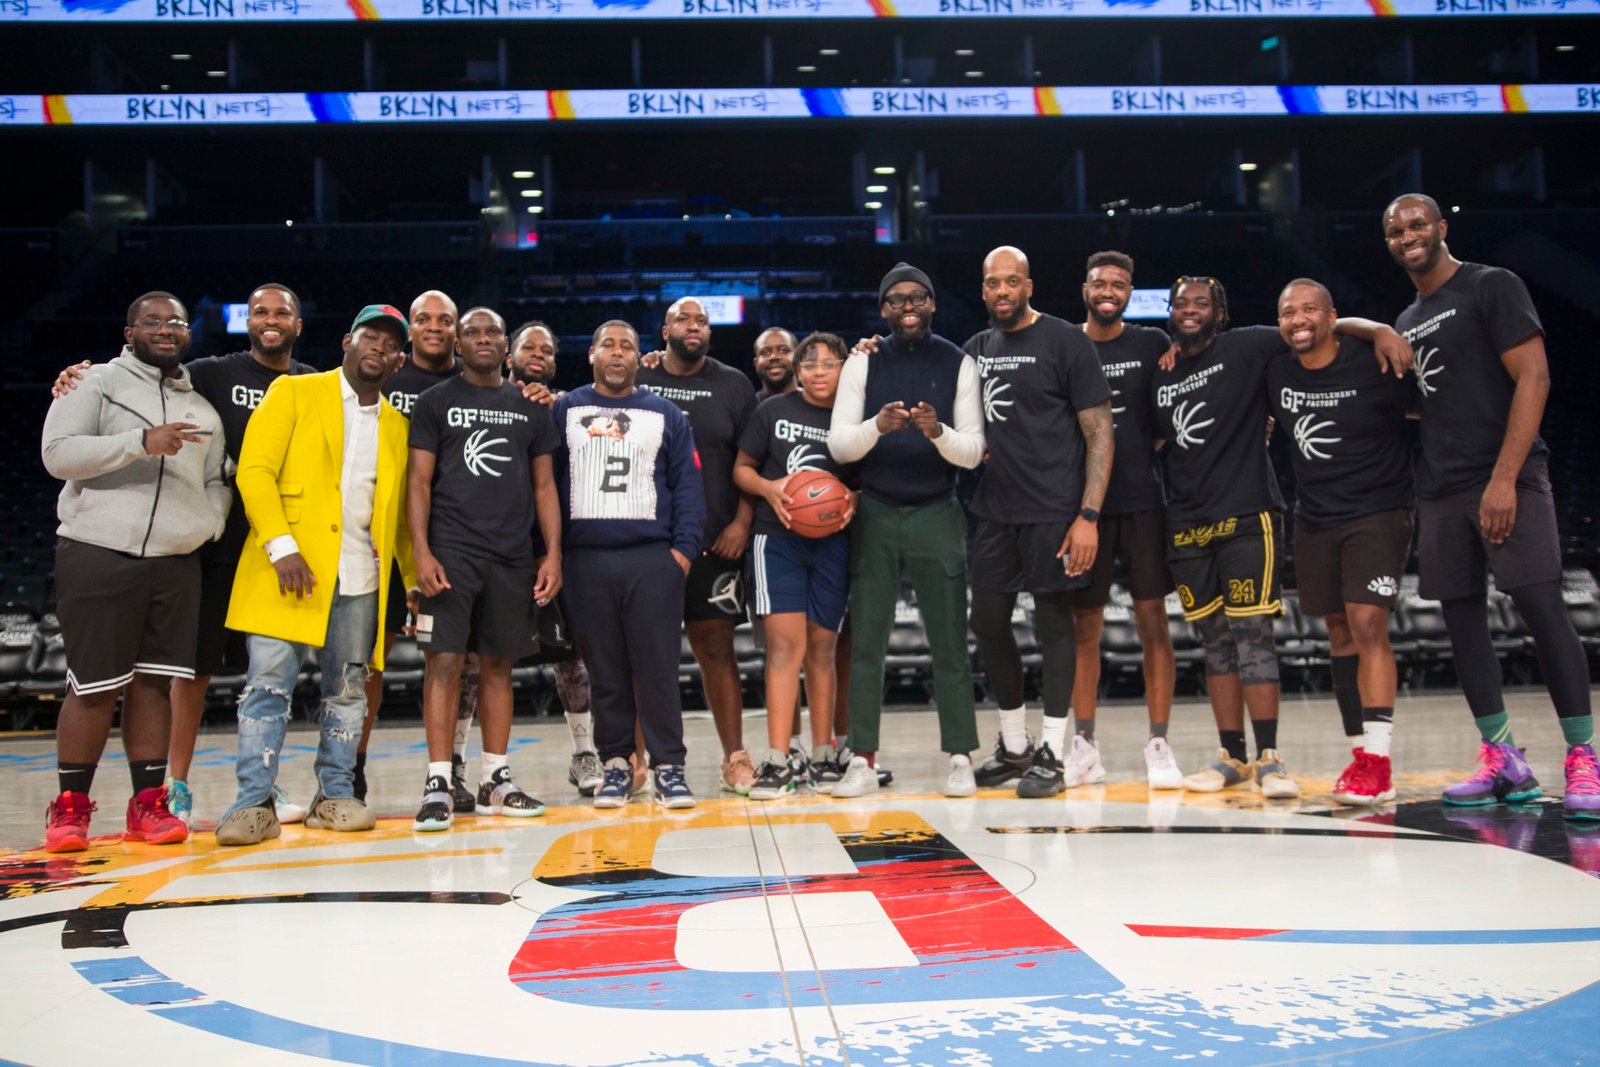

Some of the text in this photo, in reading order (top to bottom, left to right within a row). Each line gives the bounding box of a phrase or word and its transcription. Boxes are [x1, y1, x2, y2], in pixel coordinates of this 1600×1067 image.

[155, 0, 234, 17] BKLYN
[422, 0, 498, 15] BKLYN
[127, 95, 206, 120] BKLYN
[379, 93, 457, 117] BKLYN
[627, 91, 705, 114] BKLYN
[872, 89, 948, 112] BKLYN
[1111, 87, 1186, 111] BKLYN
[1345, 87, 1418, 109] BKLYN
[388, 390, 419, 414] GF
[1157, 384, 1179, 407] GF
[1281, 387, 1306, 413] GF
[1305, 399, 1339, 407] FACTORY
[447, 406, 478, 429] GF
[479, 415, 513, 425] FACTORY
[774, 418, 803, 443] GF
[599, 455, 631, 493] 2
[1229, 578, 1255, 603] 24
